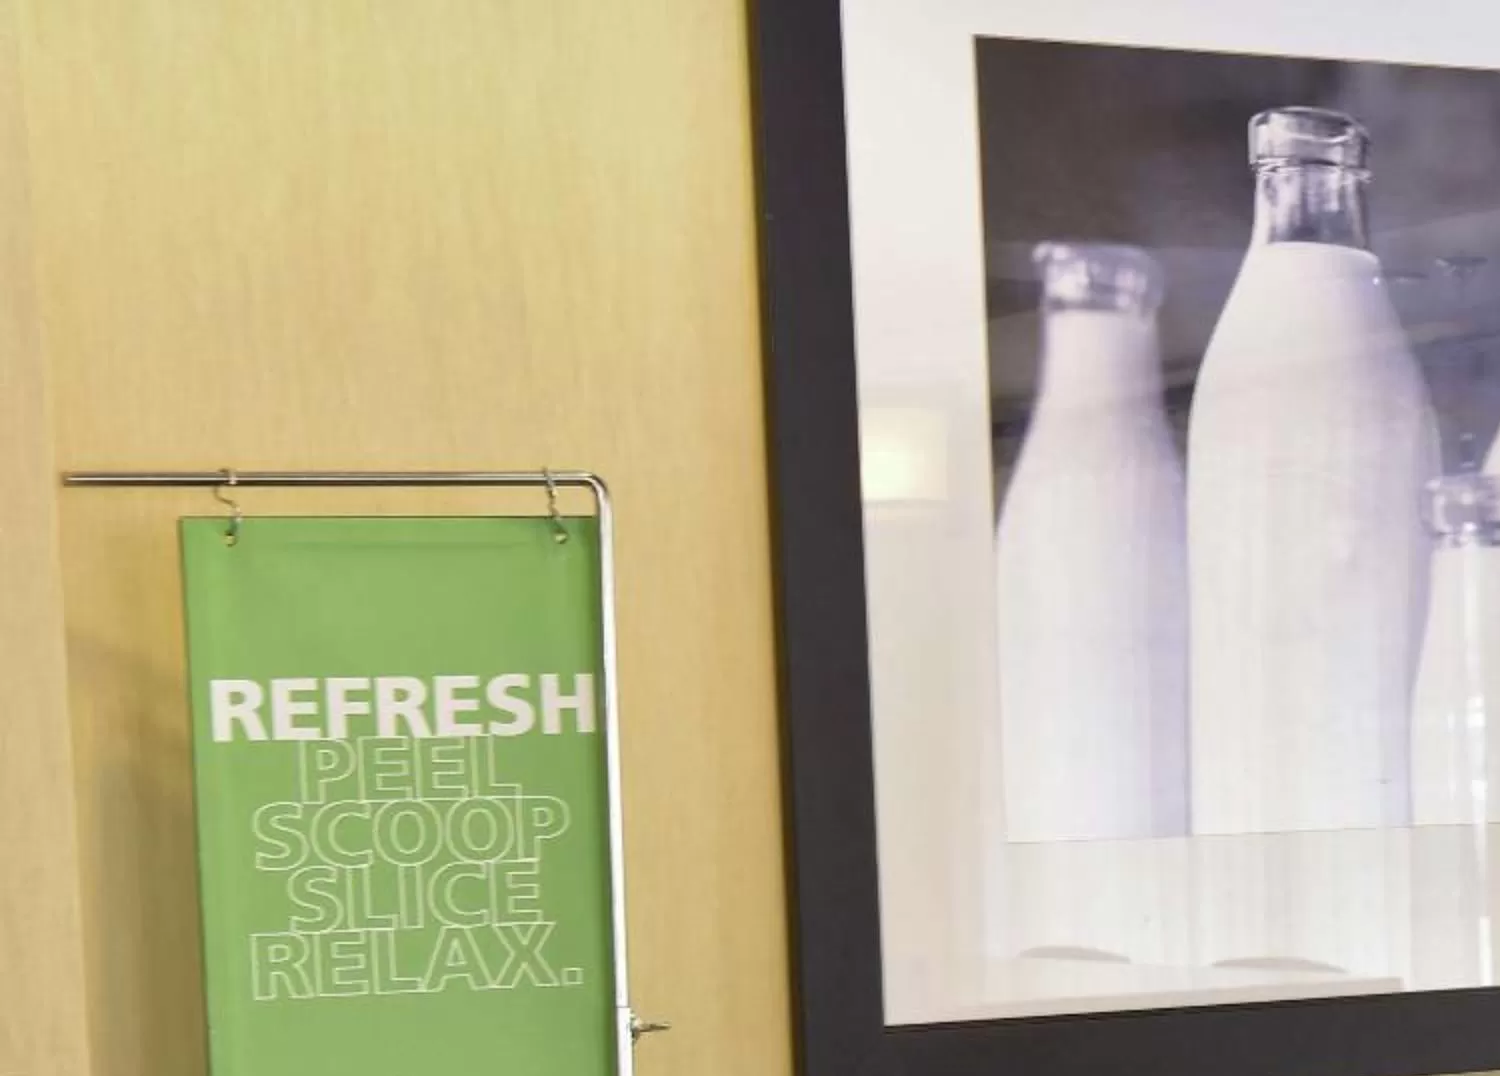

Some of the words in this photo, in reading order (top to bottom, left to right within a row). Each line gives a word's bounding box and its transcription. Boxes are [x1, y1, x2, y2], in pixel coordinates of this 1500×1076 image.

[209, 673, 597, 742] REFRESH
[301, 734, 522, 804] PEEL
[252, 795, 571, 870] SCOOP
[286, 859, 544, 934] SLICE
[249, 921, 584, 1001] RELAX.
